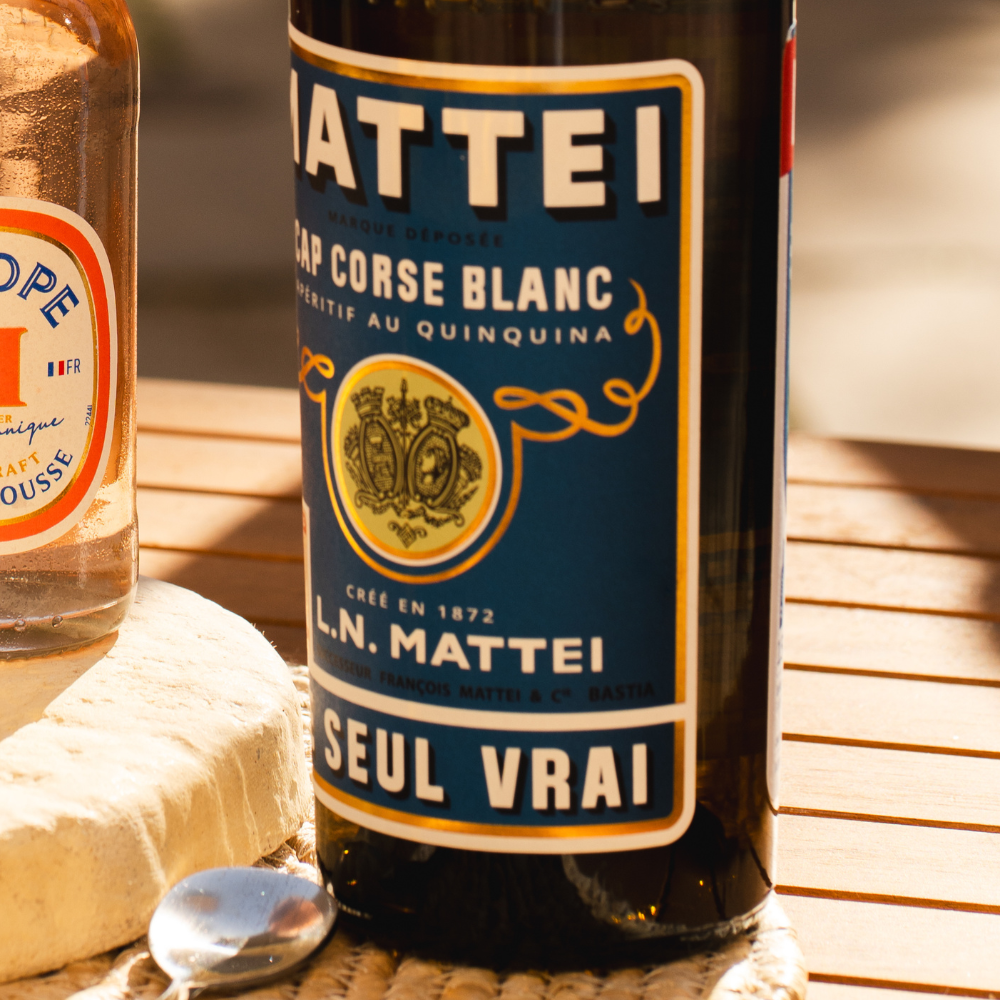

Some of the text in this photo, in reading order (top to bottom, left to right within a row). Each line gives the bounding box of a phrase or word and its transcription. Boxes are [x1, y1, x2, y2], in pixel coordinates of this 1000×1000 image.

[327, 208, 505, 249] MARQUE DÉPOSÉE
[294, 217, 613, 312] CAP CORSE BLANC
[367, 311, 400, 333] AU
[416, 320, 613, 348] QUINQUINA
[66, 358, 81, 375] FR
[346, 584, 495, 624] CRÉÉ EN 1872
[316, 594, 603, 673] L.N. MATTEI
[379, 670, 451, 698] FRANÇOIS
[459, 684, 521, 702] MATTEI
[528, 686, 543, 702] &
[588, 681, 655, 702] BASTIA
[323, 707, 648, 811] SEUL VRAI
